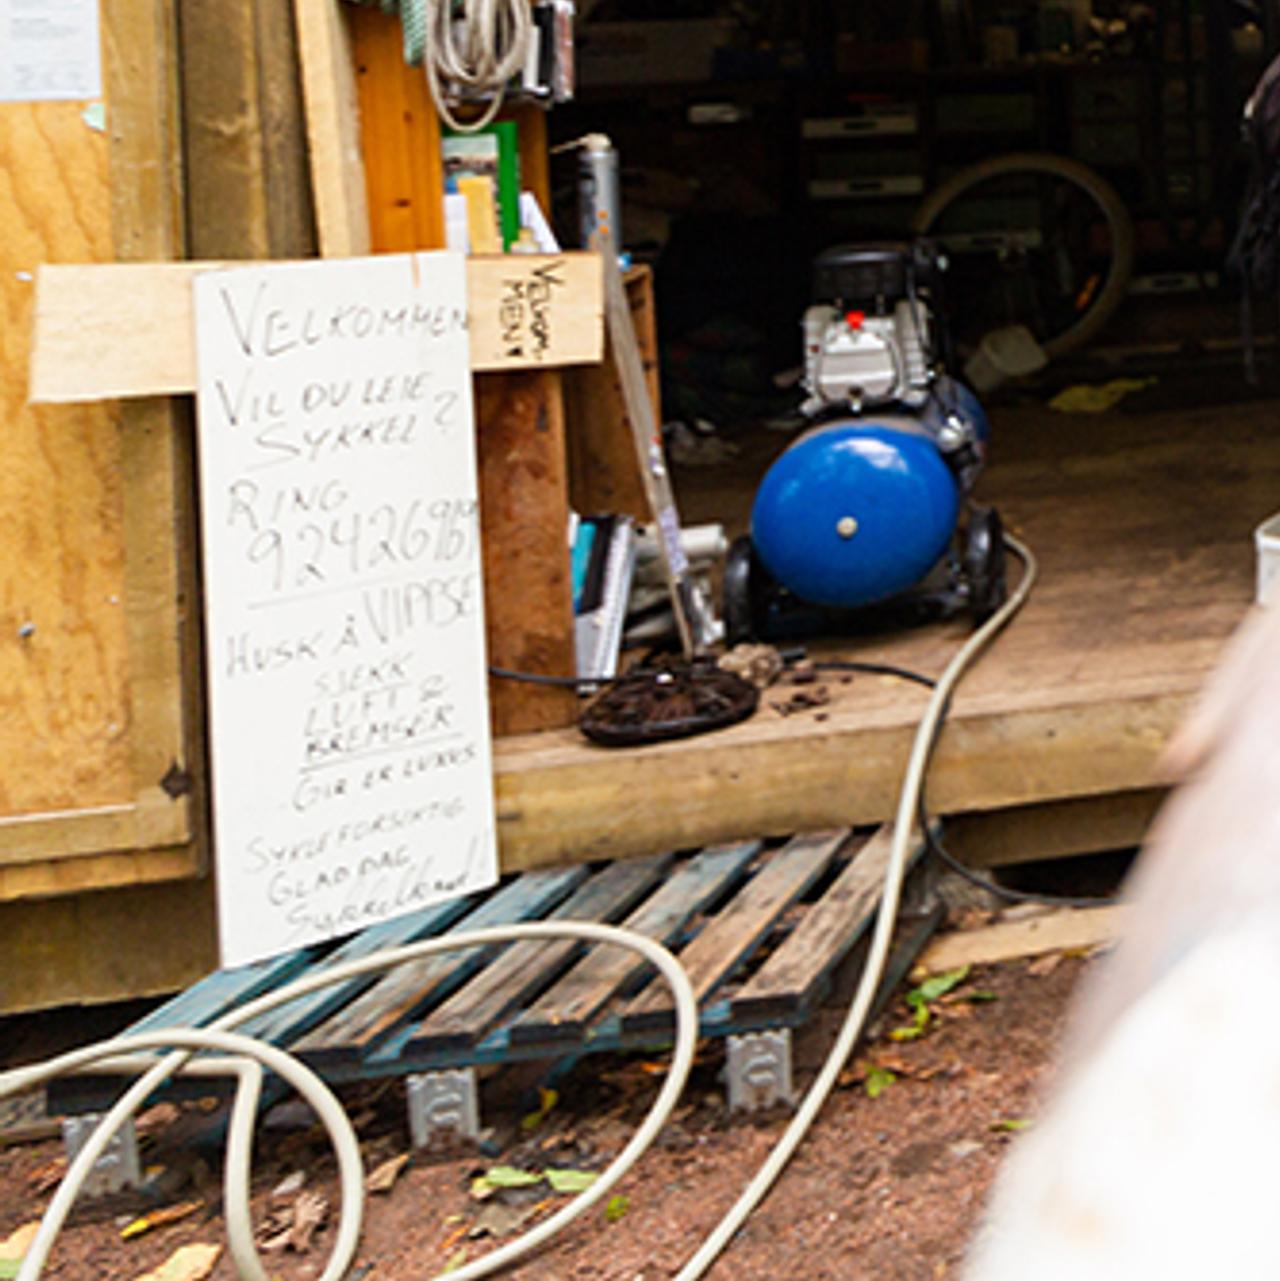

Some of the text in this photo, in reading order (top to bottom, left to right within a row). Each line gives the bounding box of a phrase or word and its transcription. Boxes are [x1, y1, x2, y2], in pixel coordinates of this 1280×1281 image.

[217, 281, 471, 357] VELKOMMEN
[214, 368, 433, 426] VIL DU LEIE
[226, 478, 349, 532] RING
[226, 631, 324, 678] HUSK
[303, 682, 411, 738] LUFT
